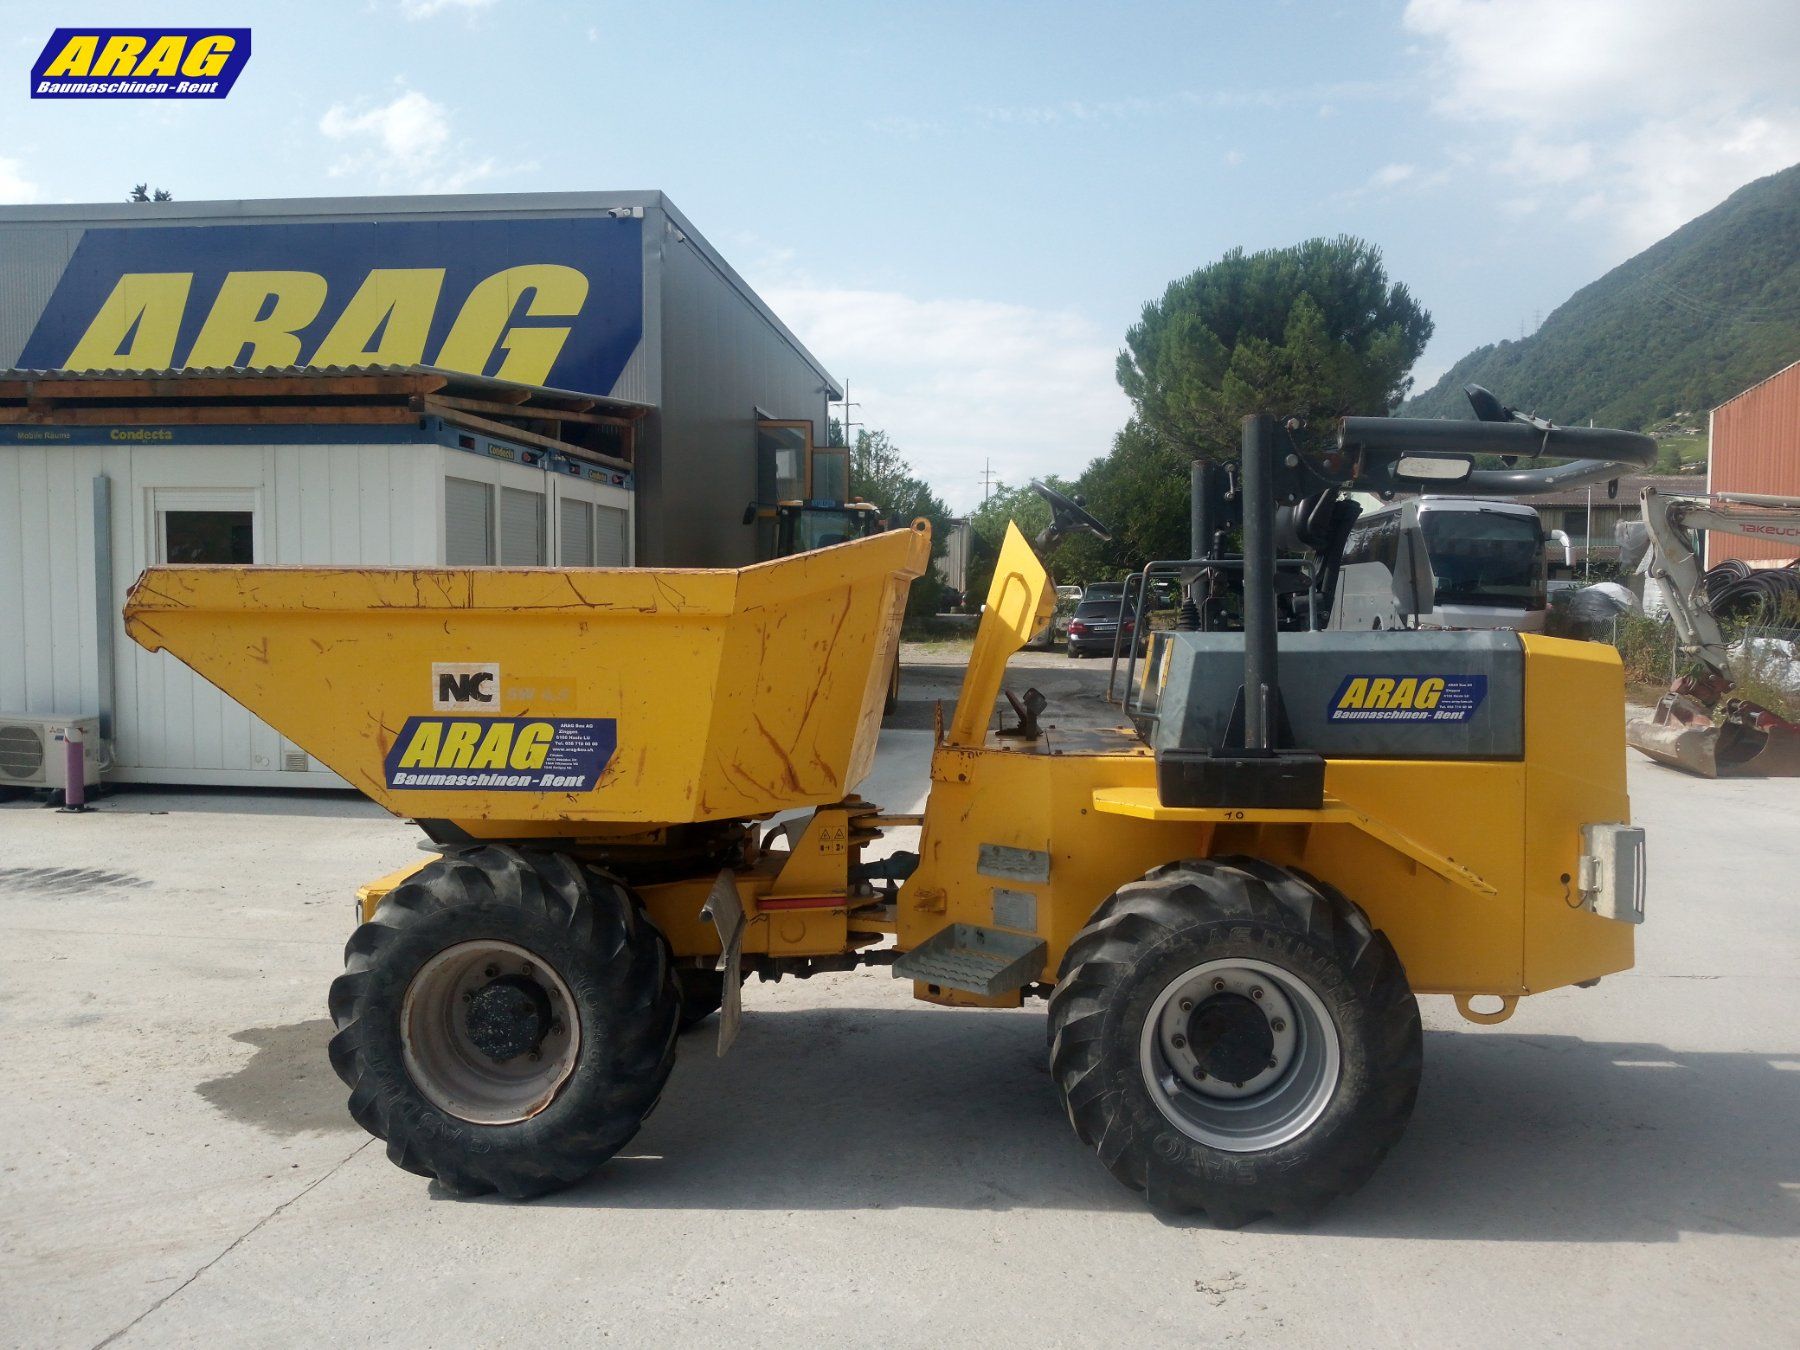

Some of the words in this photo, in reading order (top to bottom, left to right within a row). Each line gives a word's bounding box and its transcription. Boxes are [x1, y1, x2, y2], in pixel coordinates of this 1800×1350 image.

[62, 264, 590, 387] ARAG
[110, 429, 173, 440] Condecta
[439, 672, 494, 702] NC
[1337, 678, 1445, 709] ARAG
[398, 722, 554, 770] ARAG
